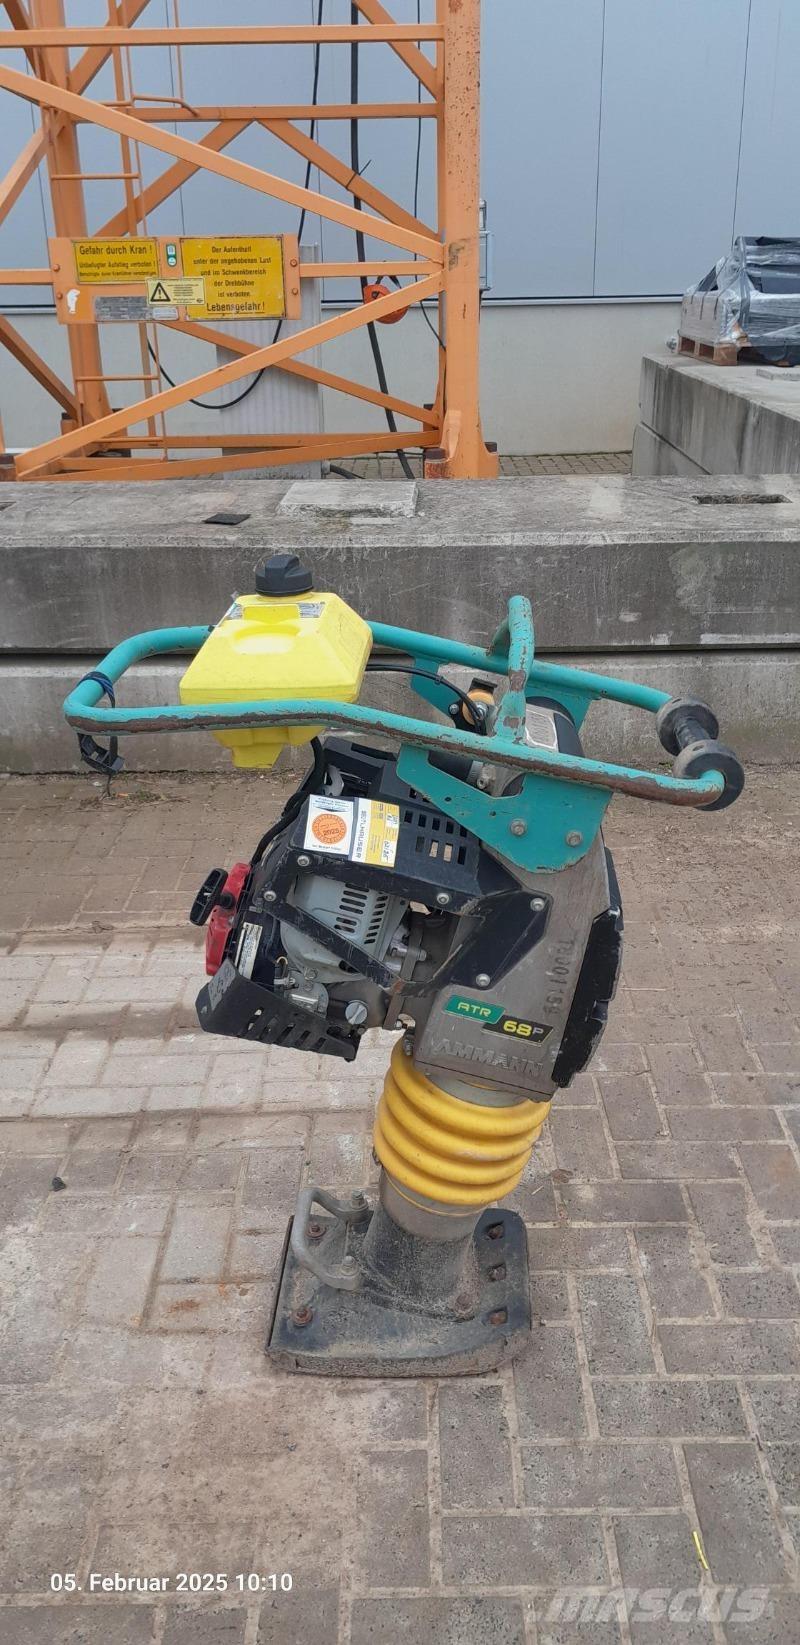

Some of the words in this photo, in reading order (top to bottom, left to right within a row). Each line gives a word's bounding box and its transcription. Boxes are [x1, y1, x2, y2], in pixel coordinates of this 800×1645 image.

[80, 245, 103, 255] Gefahr
[105, 245, 127, 254] durch
[129, 245, 147, 254] Kran
[212, 268, 221, 276] im
[222, 268, 267, 276] Schwenkbereich
[225, 279, 255, 287] Drehbühne
[457, 1001, 492, 1017] ATR
[433, 1038, 543, 1074] AMMANN
